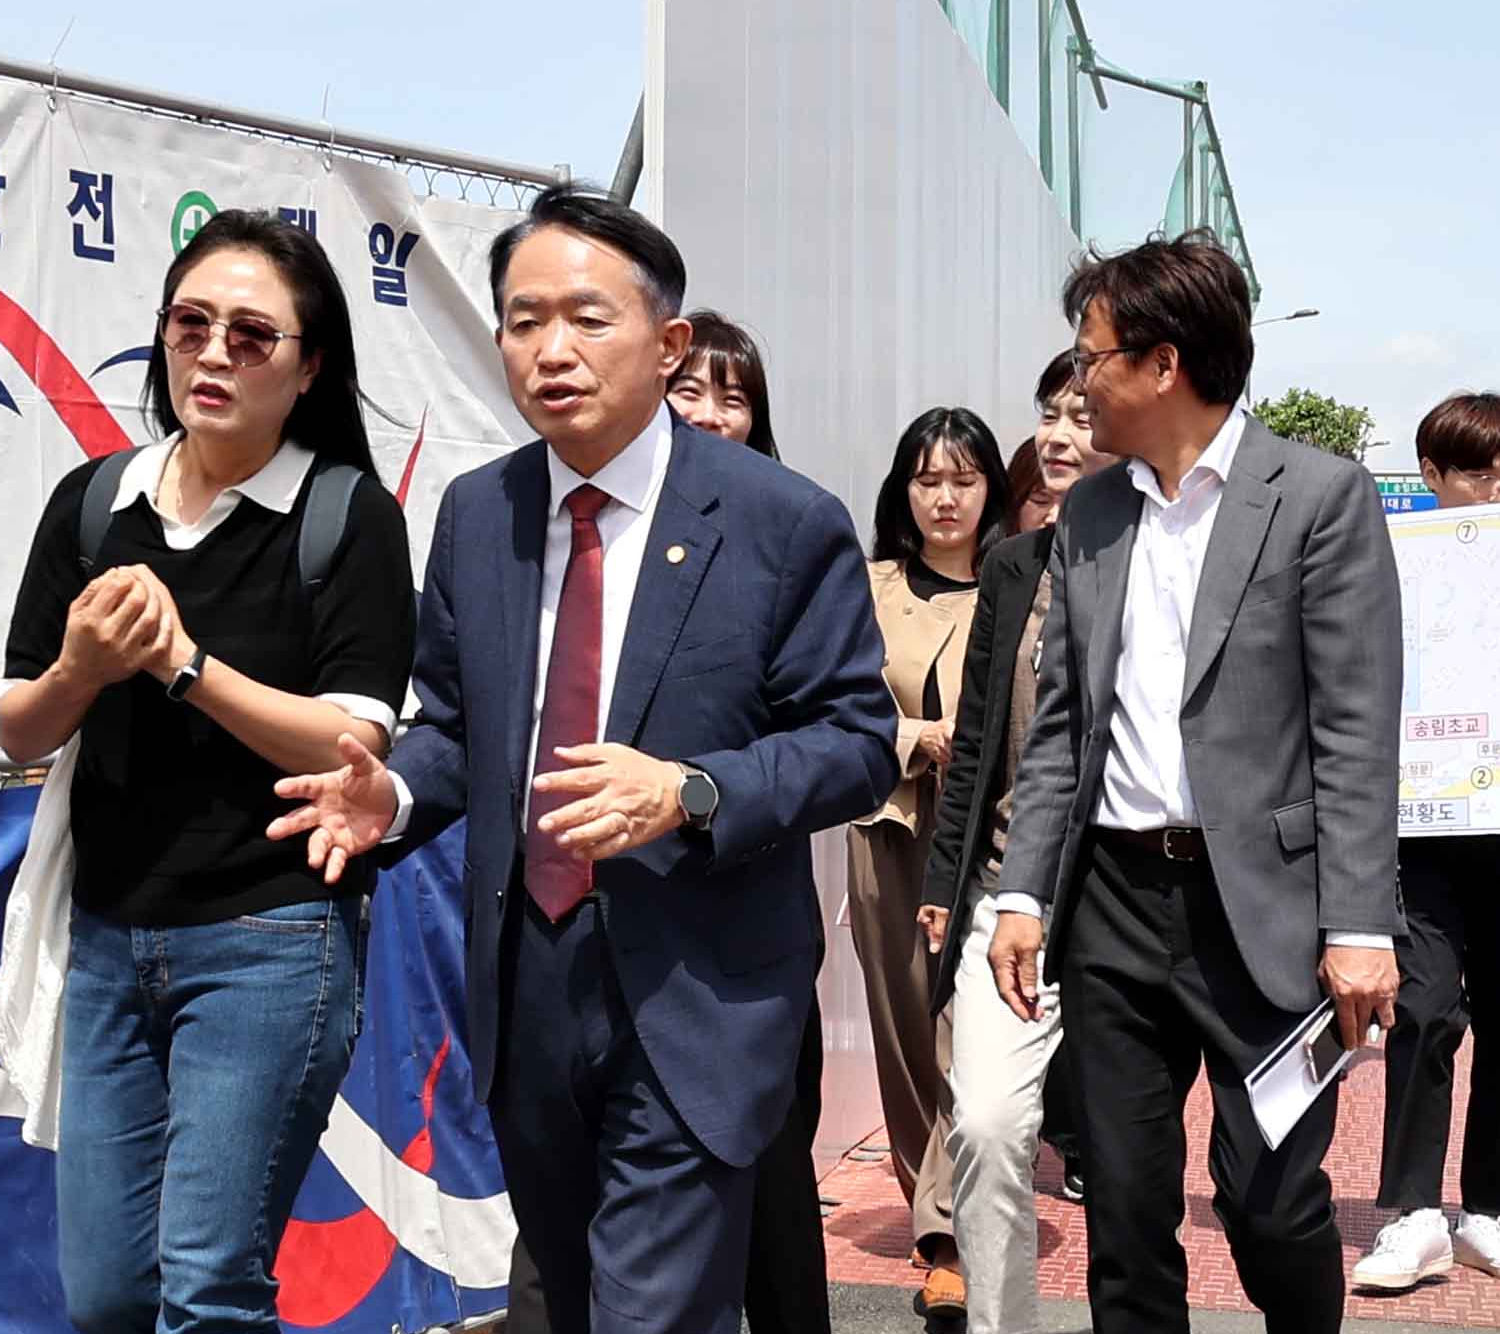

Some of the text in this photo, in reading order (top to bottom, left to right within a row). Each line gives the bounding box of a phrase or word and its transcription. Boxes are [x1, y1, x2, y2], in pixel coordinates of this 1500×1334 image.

[1382, 498, 1412, 509] 대로
[1414, 717, 1480, 737] 송림초교
[1398, 802, 1457, 824] 현황도
